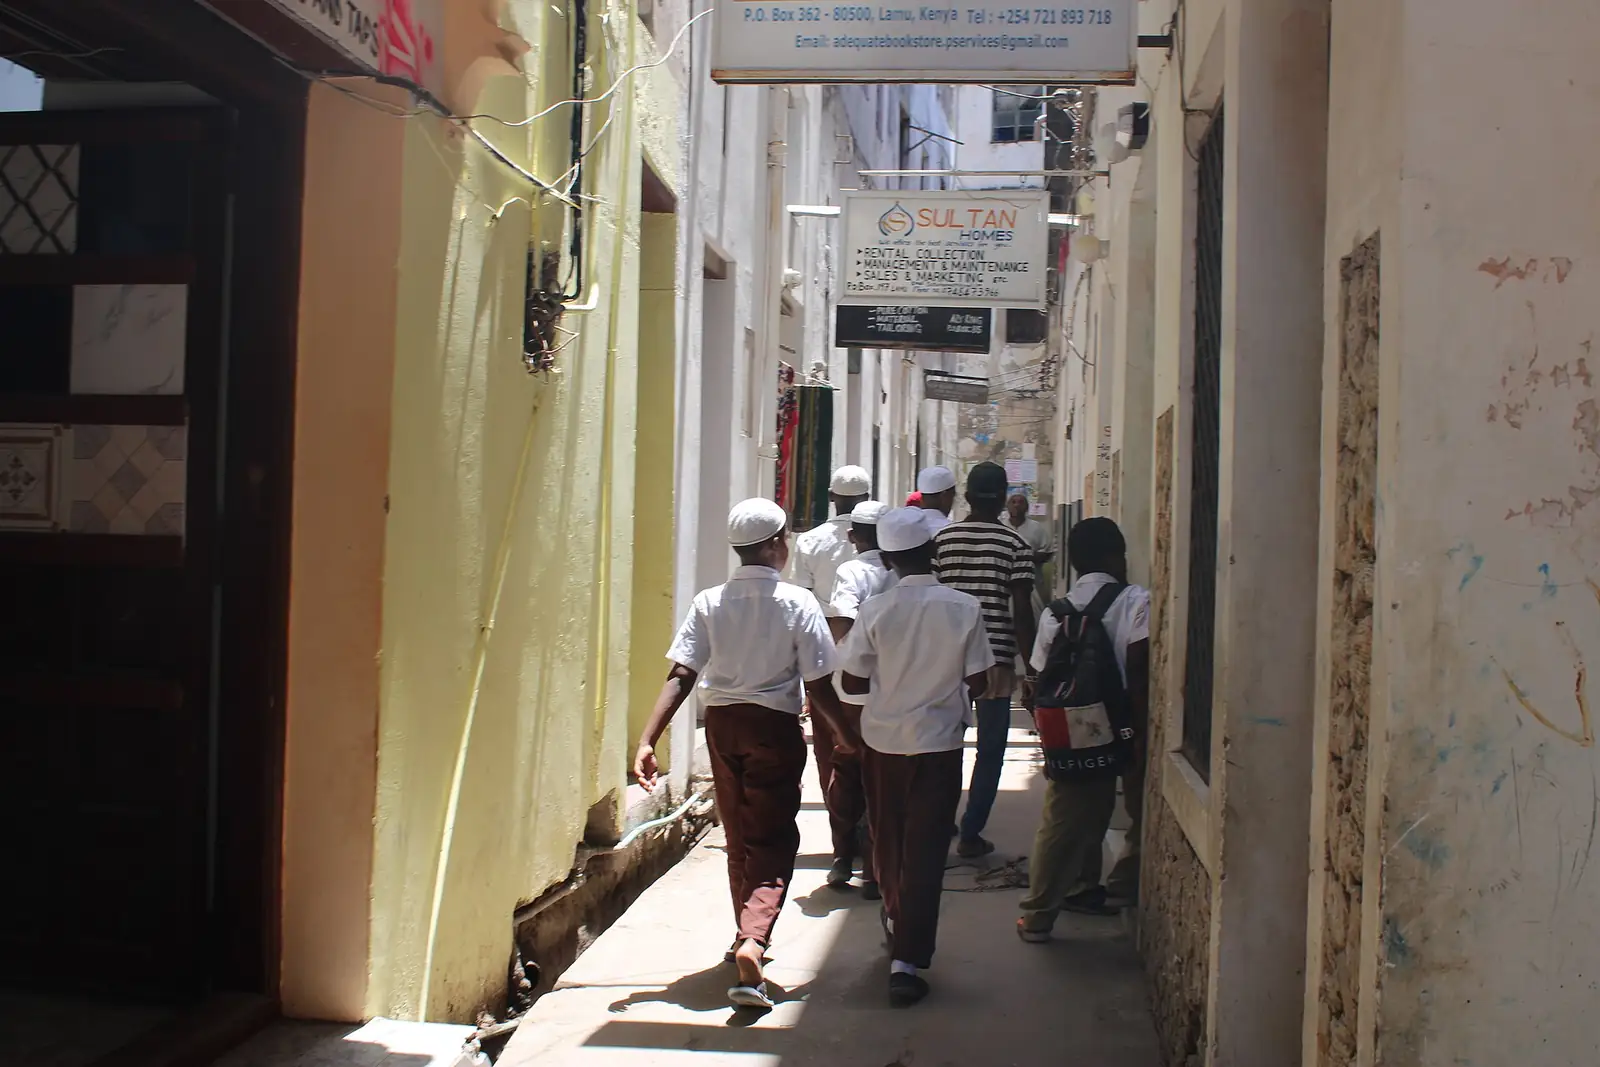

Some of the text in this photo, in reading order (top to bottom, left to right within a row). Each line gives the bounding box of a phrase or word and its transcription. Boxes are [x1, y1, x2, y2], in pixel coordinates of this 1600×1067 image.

[744, 8, 768, 22] P.O.
[772, 8, 794, 22] Box
[798, 7, 821, 21] 362
[833, 7, 875, 24] 80500,
[879, 7, 916, 24] Lamu,
[919, 7, 958, 24] Kenya
[967, 9, 985, 24] Tel
[997, 9, 1030, 25] +254
[1033, 10, 1056, 24] 721
[1060, 10, 1084, 24] 893
[1088, 10, 1112, 24] 718
[795, 35, 830, 48] Email:
[916, 207, 1018, 229] SULTAN
[960, 230, 1014, 241] HOMES
[863, 247, 985, 261] RENTAL COLLECTION
[863, 259, 1029, 273] MANAGEMENT & MAINTENANCE
[863, 270, 898, 281] SALES
[905, 272, 912, 281] &
[917, 272, 984, 284] MARKETING
[876, 323, 922, 334] TAILORING
